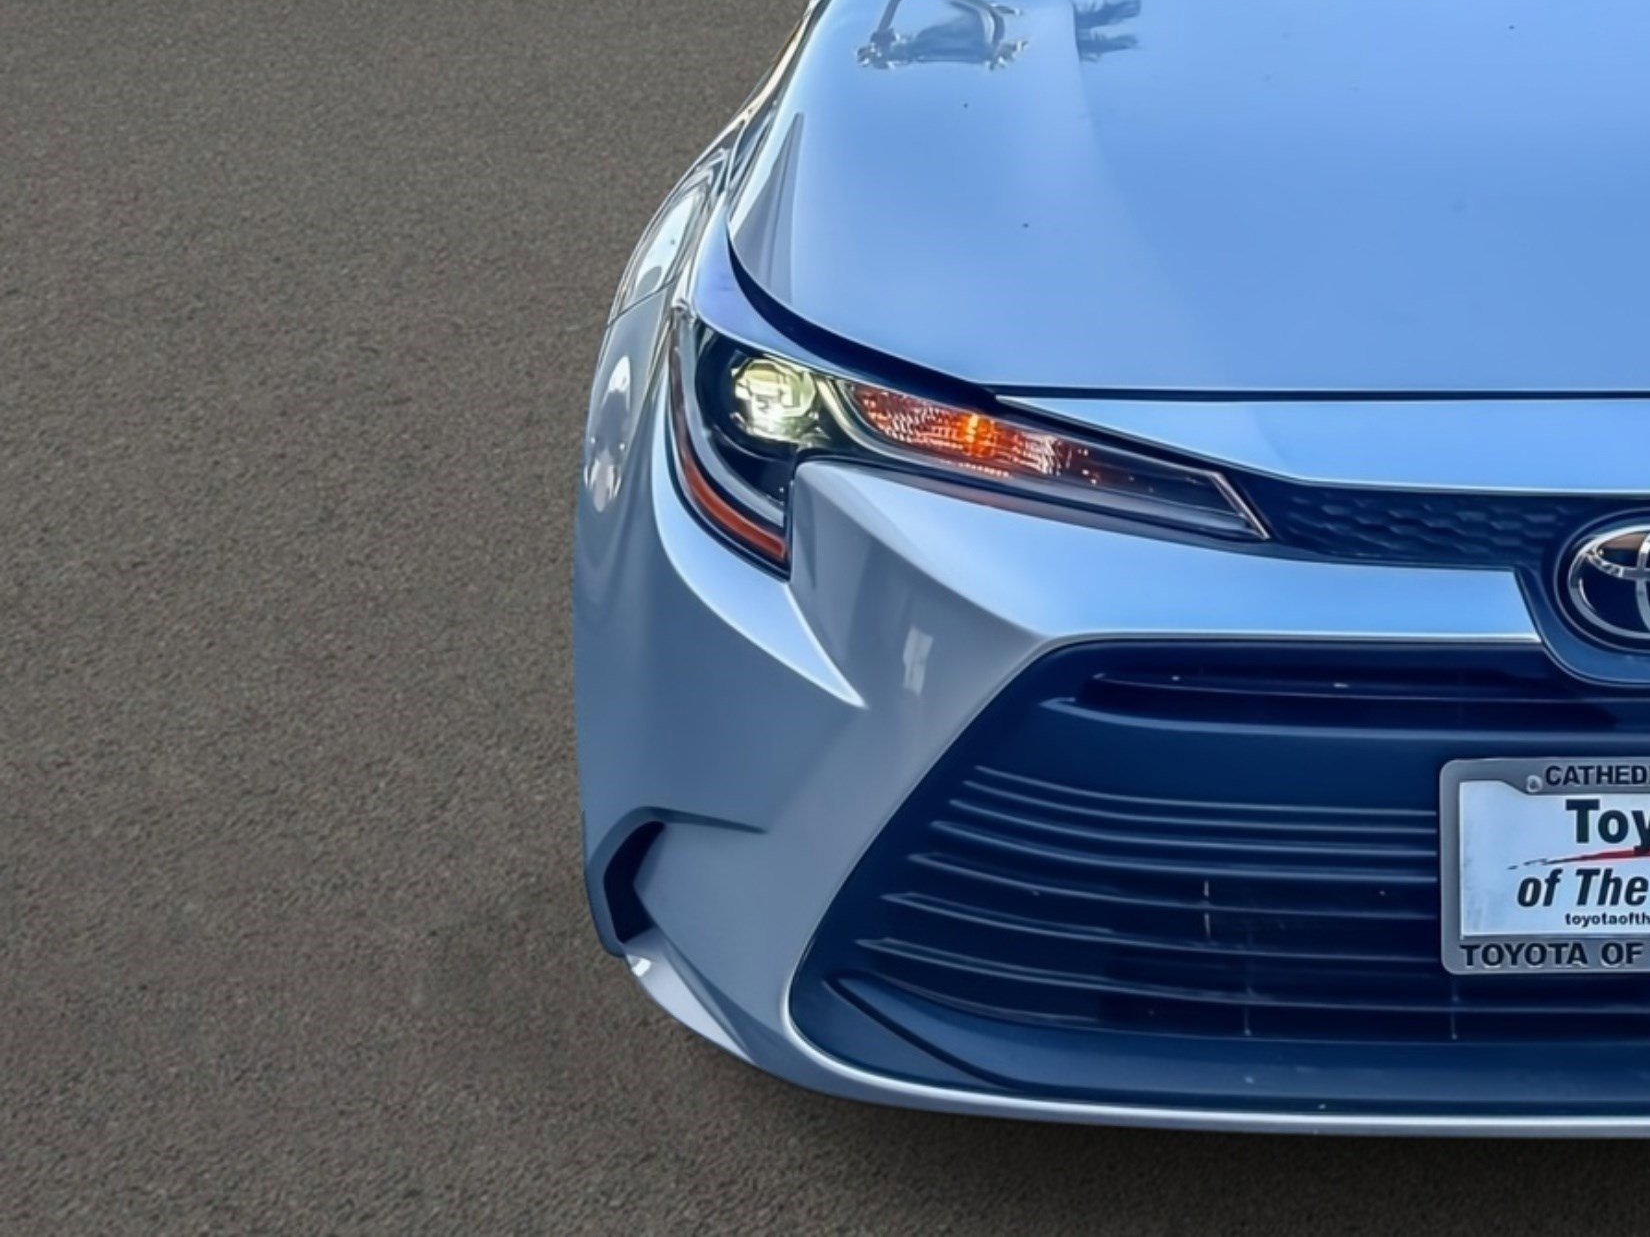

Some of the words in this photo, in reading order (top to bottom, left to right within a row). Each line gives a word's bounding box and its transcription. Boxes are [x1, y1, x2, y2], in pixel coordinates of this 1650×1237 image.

[1517, 868, 1563, 907] of
[1575, 868, 1649, 906] The
[1459, 942, 1589, 966] TOYOTA
[1601, 942, 1644, 965] OF
